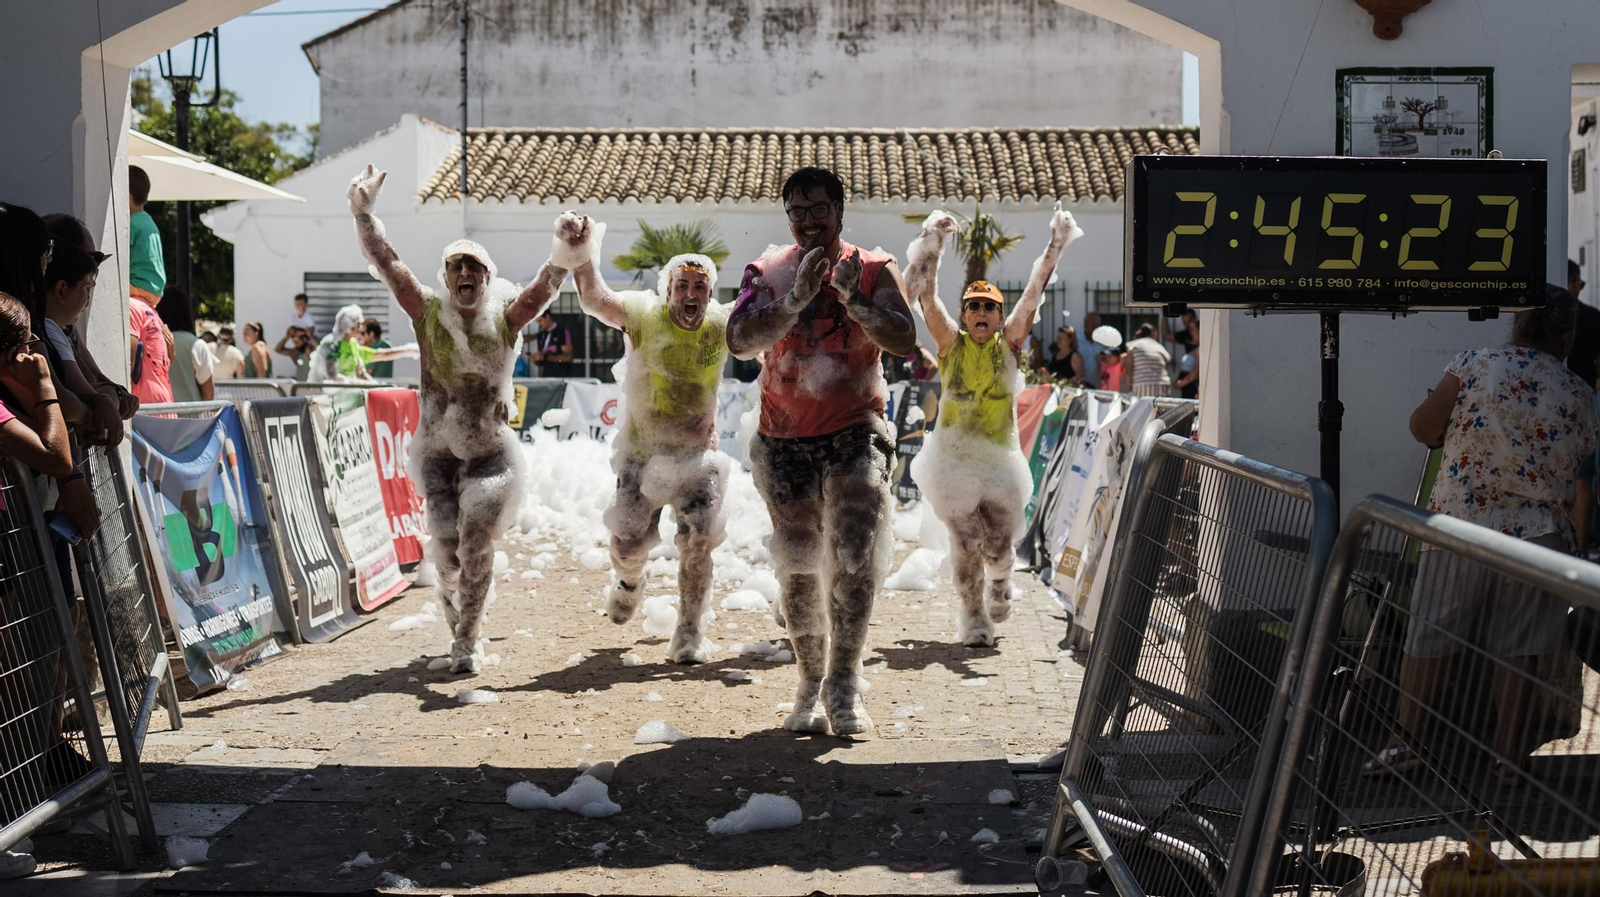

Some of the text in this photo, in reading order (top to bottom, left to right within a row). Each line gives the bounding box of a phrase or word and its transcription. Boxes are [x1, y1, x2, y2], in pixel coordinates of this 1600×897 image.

[1163, 191, 1519, 271] 2:45:23
[1152, 276, 1527, 290] www.gesconchip.es 615 980 784 info@gesconchip.es
